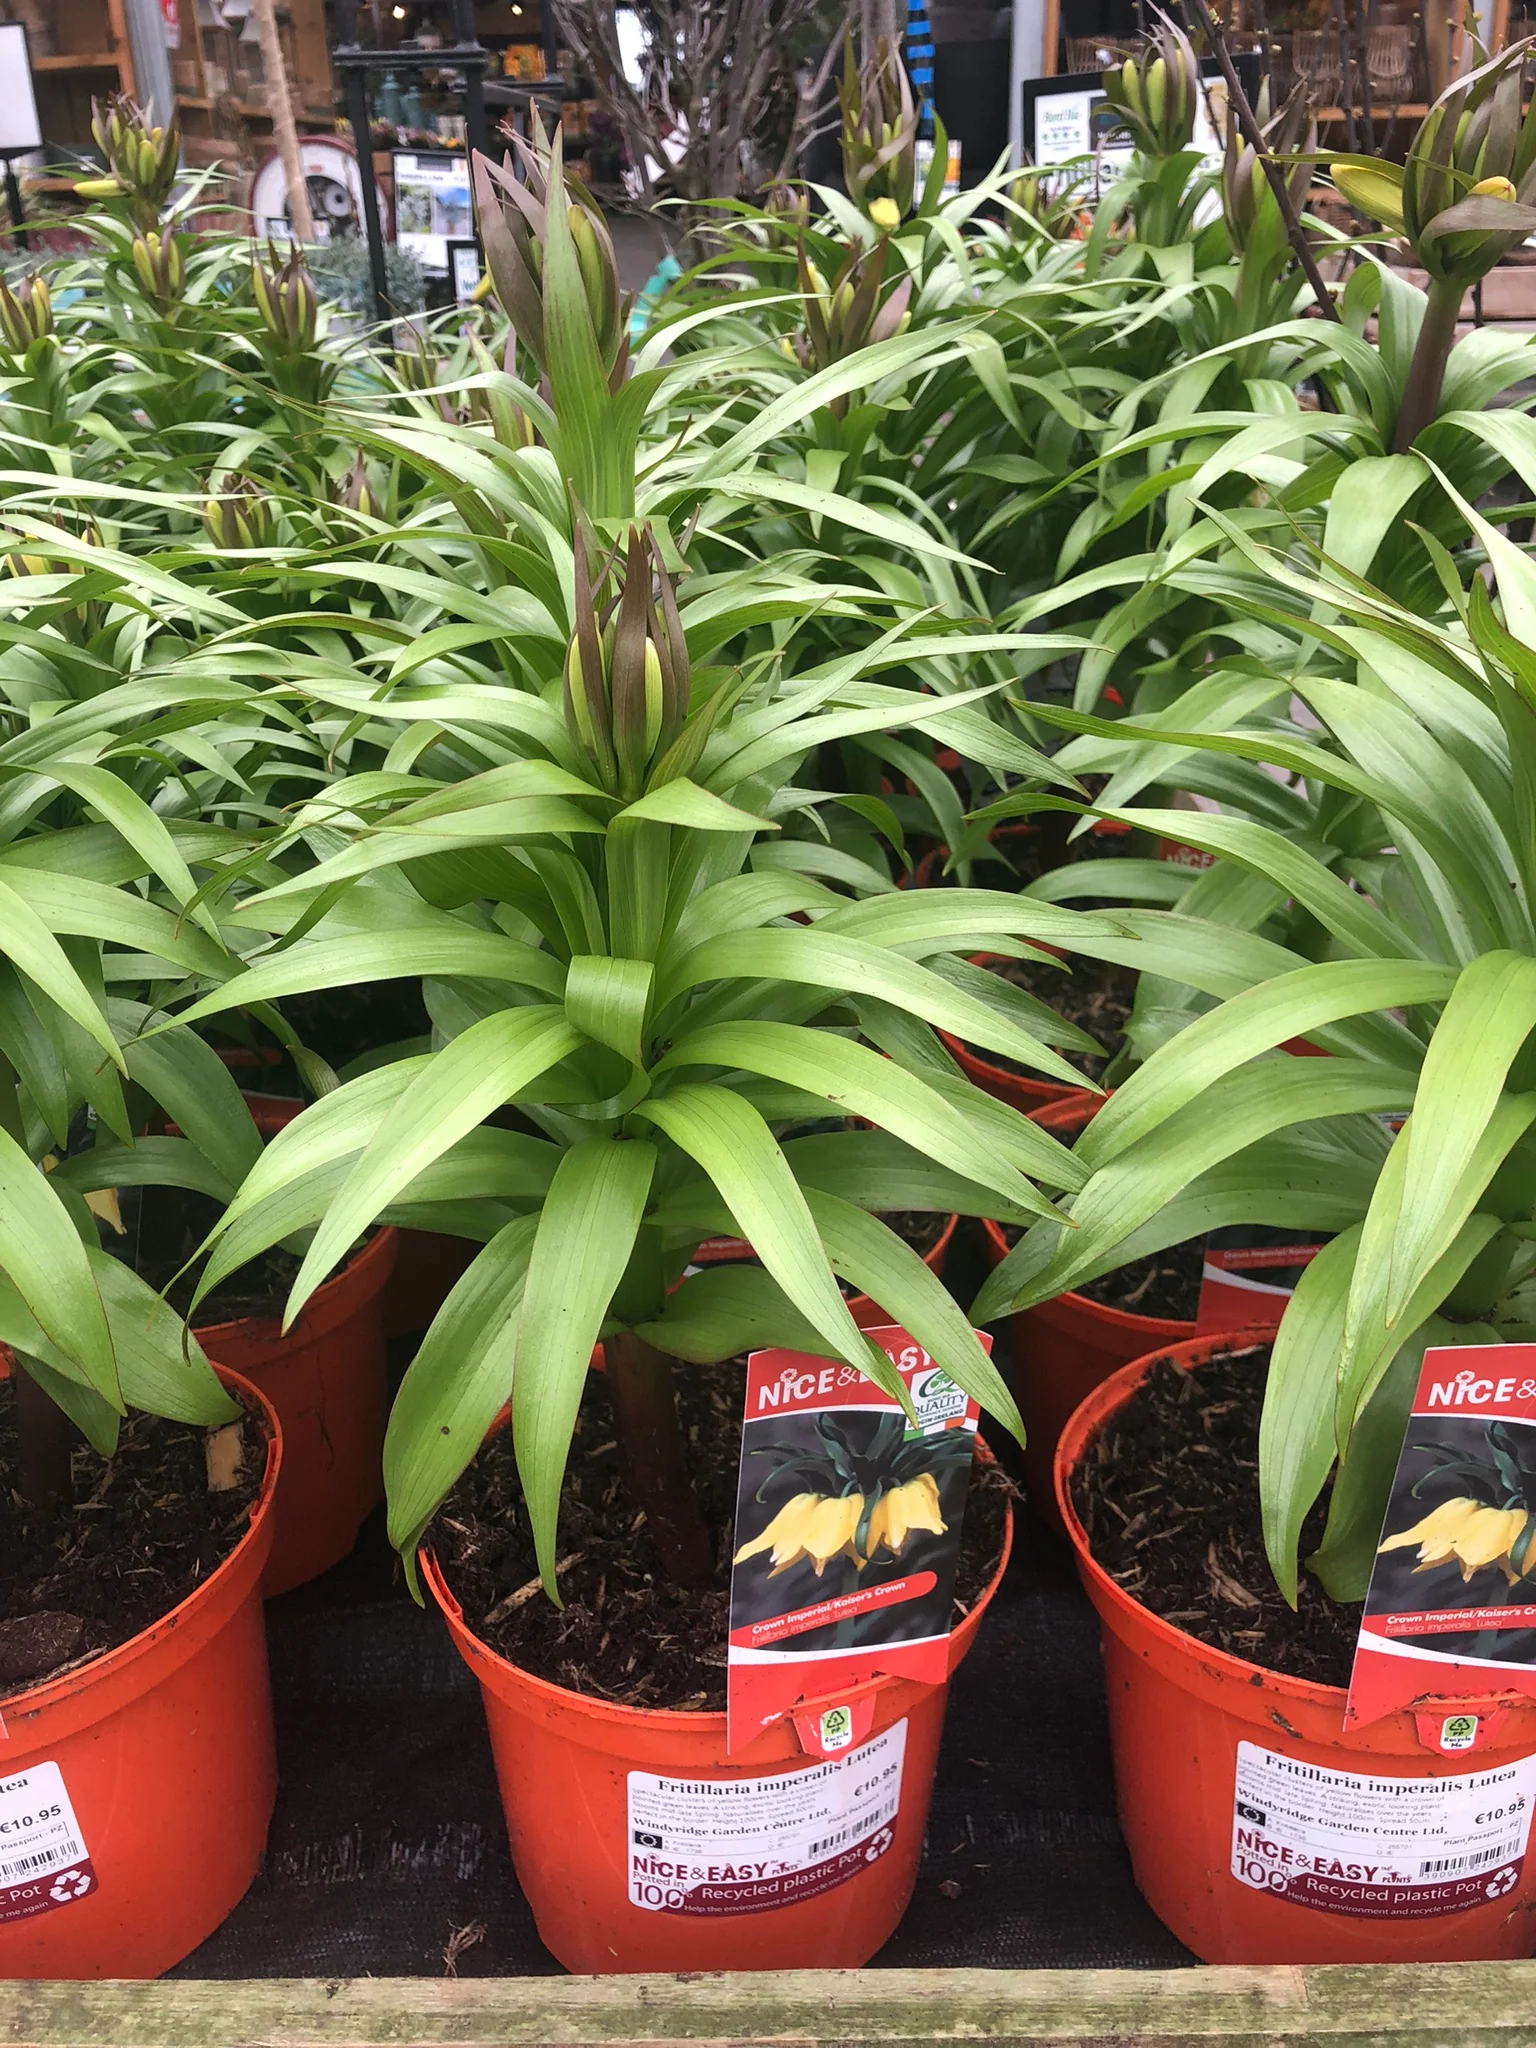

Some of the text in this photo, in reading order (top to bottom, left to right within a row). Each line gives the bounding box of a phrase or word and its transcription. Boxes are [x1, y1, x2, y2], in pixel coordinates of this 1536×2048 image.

[752, 1581, 906, 1634] Crown Imperial/Kaiser's Crown
[1387, 1615, 1422, 1625] Crown
[1425, 1607, 1521, 1622] Imperial/Kaiser's
[824, 1731, 850, 1745] Recycle
[832, 1740, 843, 1748] Me
[1443, 1735, 1472, 1744] Recycle
[659, 1738, 888, 1795] Fritillaria imperalis Lutea
[853, 1761, 899, 1797] €10.95
[1266, 1754, 1516, 1796] Fritillaria imperalis Lutea
[0, 1804, 62, 1834] €10.95
[634, 1816, 709, 1837] Windyridge
[712, 1825, 761, 1836] Garden
[763, 1816, 806, 1832] Centre
[808, 1807, 832, 1820] Ltd.
[1238, 1787, 1314, 1822] Windyridge
[1318, 1817, 1369, 1834] Garden
[1373, 1826, 1418, 1836] Centre
[1422, 1826, 1448, 1836] Ltd.
[1474, 1799, 1526, 1825] €10.95
[0, 1824, 64, 1850] Passport PZ
[1443, 1838, 1466, 1847] Plant
[1467, 1827, 1504, 1842] Passport
[1236, 1843, 1290, 1873] Potted in
[633, 1871, 685, 1888] Potted in
[702, 1881, 779, 1901] Recycled
[783, 1863, 835, 1892] plastic
[838, 1848, 862, 1868] Pot
[9, 1885, 42, 1902] Pot
[684, 1905, 706, 1914] Help
[707, 1904, 723, 1913] the
[723, 1900, 780, 1913] environment
[781, 1892, 798, 1904] and
[1287, 1890, 1309, 1902] Help
[1311, 1896, 1327, 1907] the
[1328, 1902, 1389, 1915] environment
[1410, 1905, 1442, 1915] recycle
[1443, 1902, 1457, 1911] me
[1459, 1896, 1481, 1908] again
[1307, 1877, 1389, 1901] Recycled
[1393, 1887, 1452, 1904] plastic
[1455, 1880, 1482, 1895] Pot
[6, 1909, 21, 1918] me
[22, 1901, 49, 1914] again
